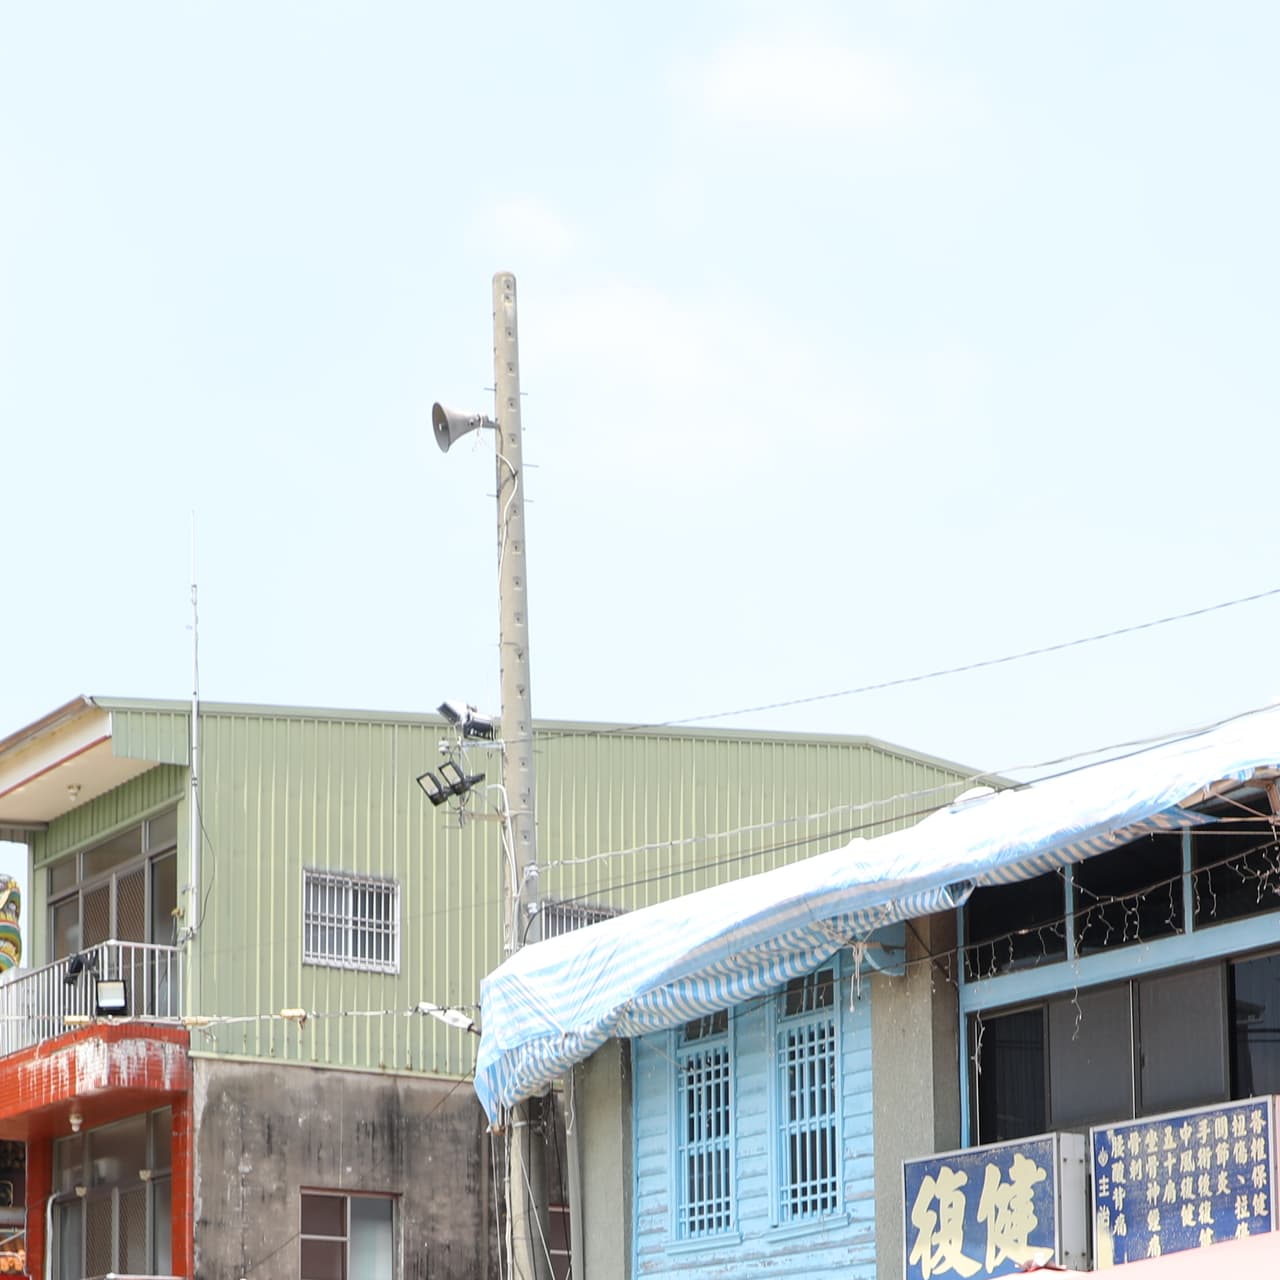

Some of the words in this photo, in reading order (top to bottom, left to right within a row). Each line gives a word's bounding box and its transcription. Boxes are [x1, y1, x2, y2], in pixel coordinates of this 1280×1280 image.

[1128, 1131, 1142, 1181] 骨刺
[1162, 1125, 1177, 1204] 五十肩
[1179, 1121, 1196, 1227] 中風復健
[1214, 1115, 1231, 1196] 關節炎
[1250, 1109, 1269, 1217] 脊椎保健
[909, 1153, 1054, 1280] 復健
